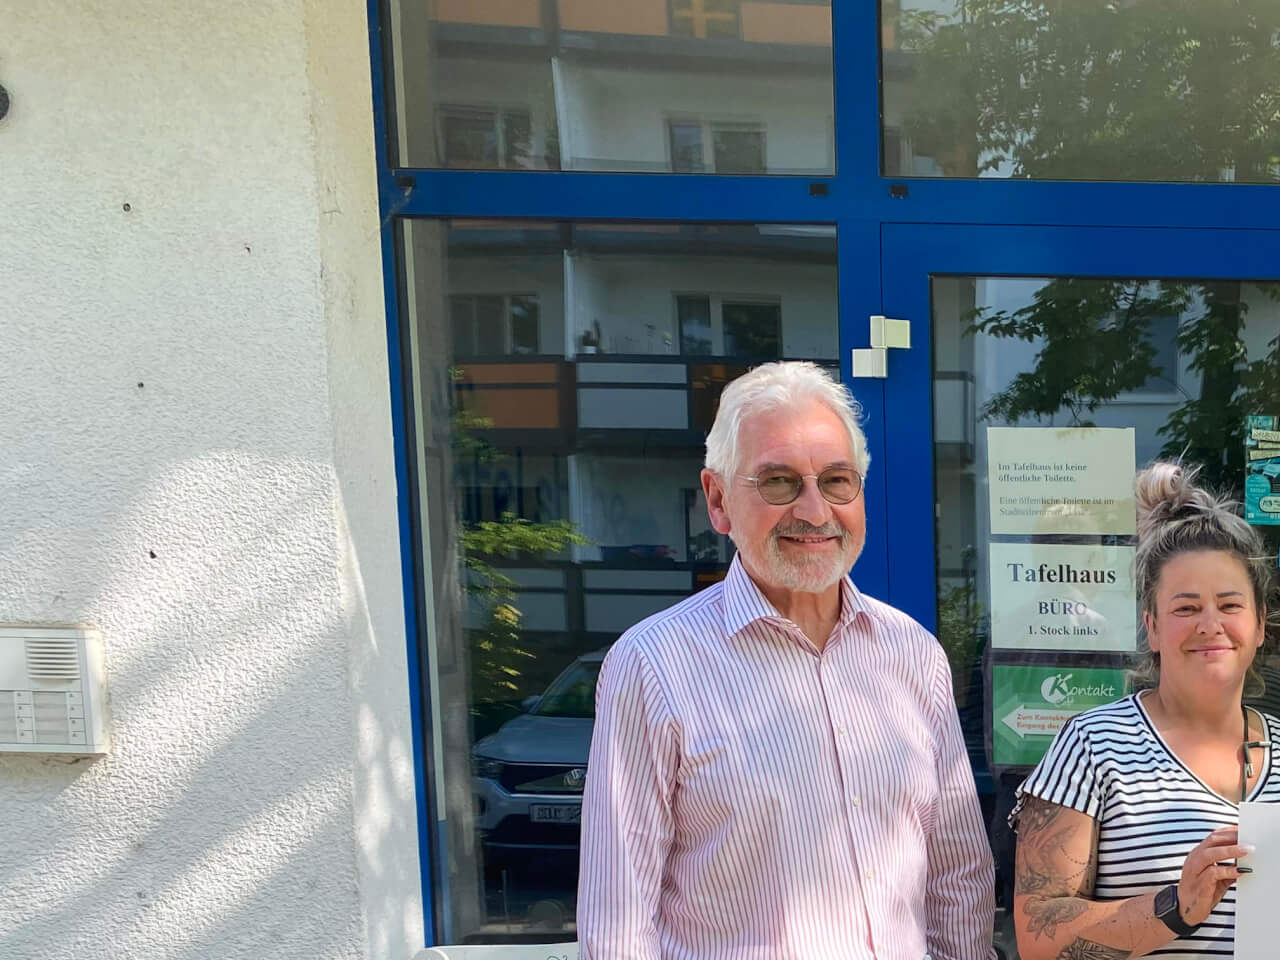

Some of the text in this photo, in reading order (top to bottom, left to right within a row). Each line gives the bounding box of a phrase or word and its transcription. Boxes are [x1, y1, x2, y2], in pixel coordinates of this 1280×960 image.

[1007, 562, 1116, 584] Tafelhaus
[1038, 598, 1087, 615] BÜRO
[1028, 625, 1098, 635] 1. Stock links
[1047, 673, 1115, 697] Kontakt
